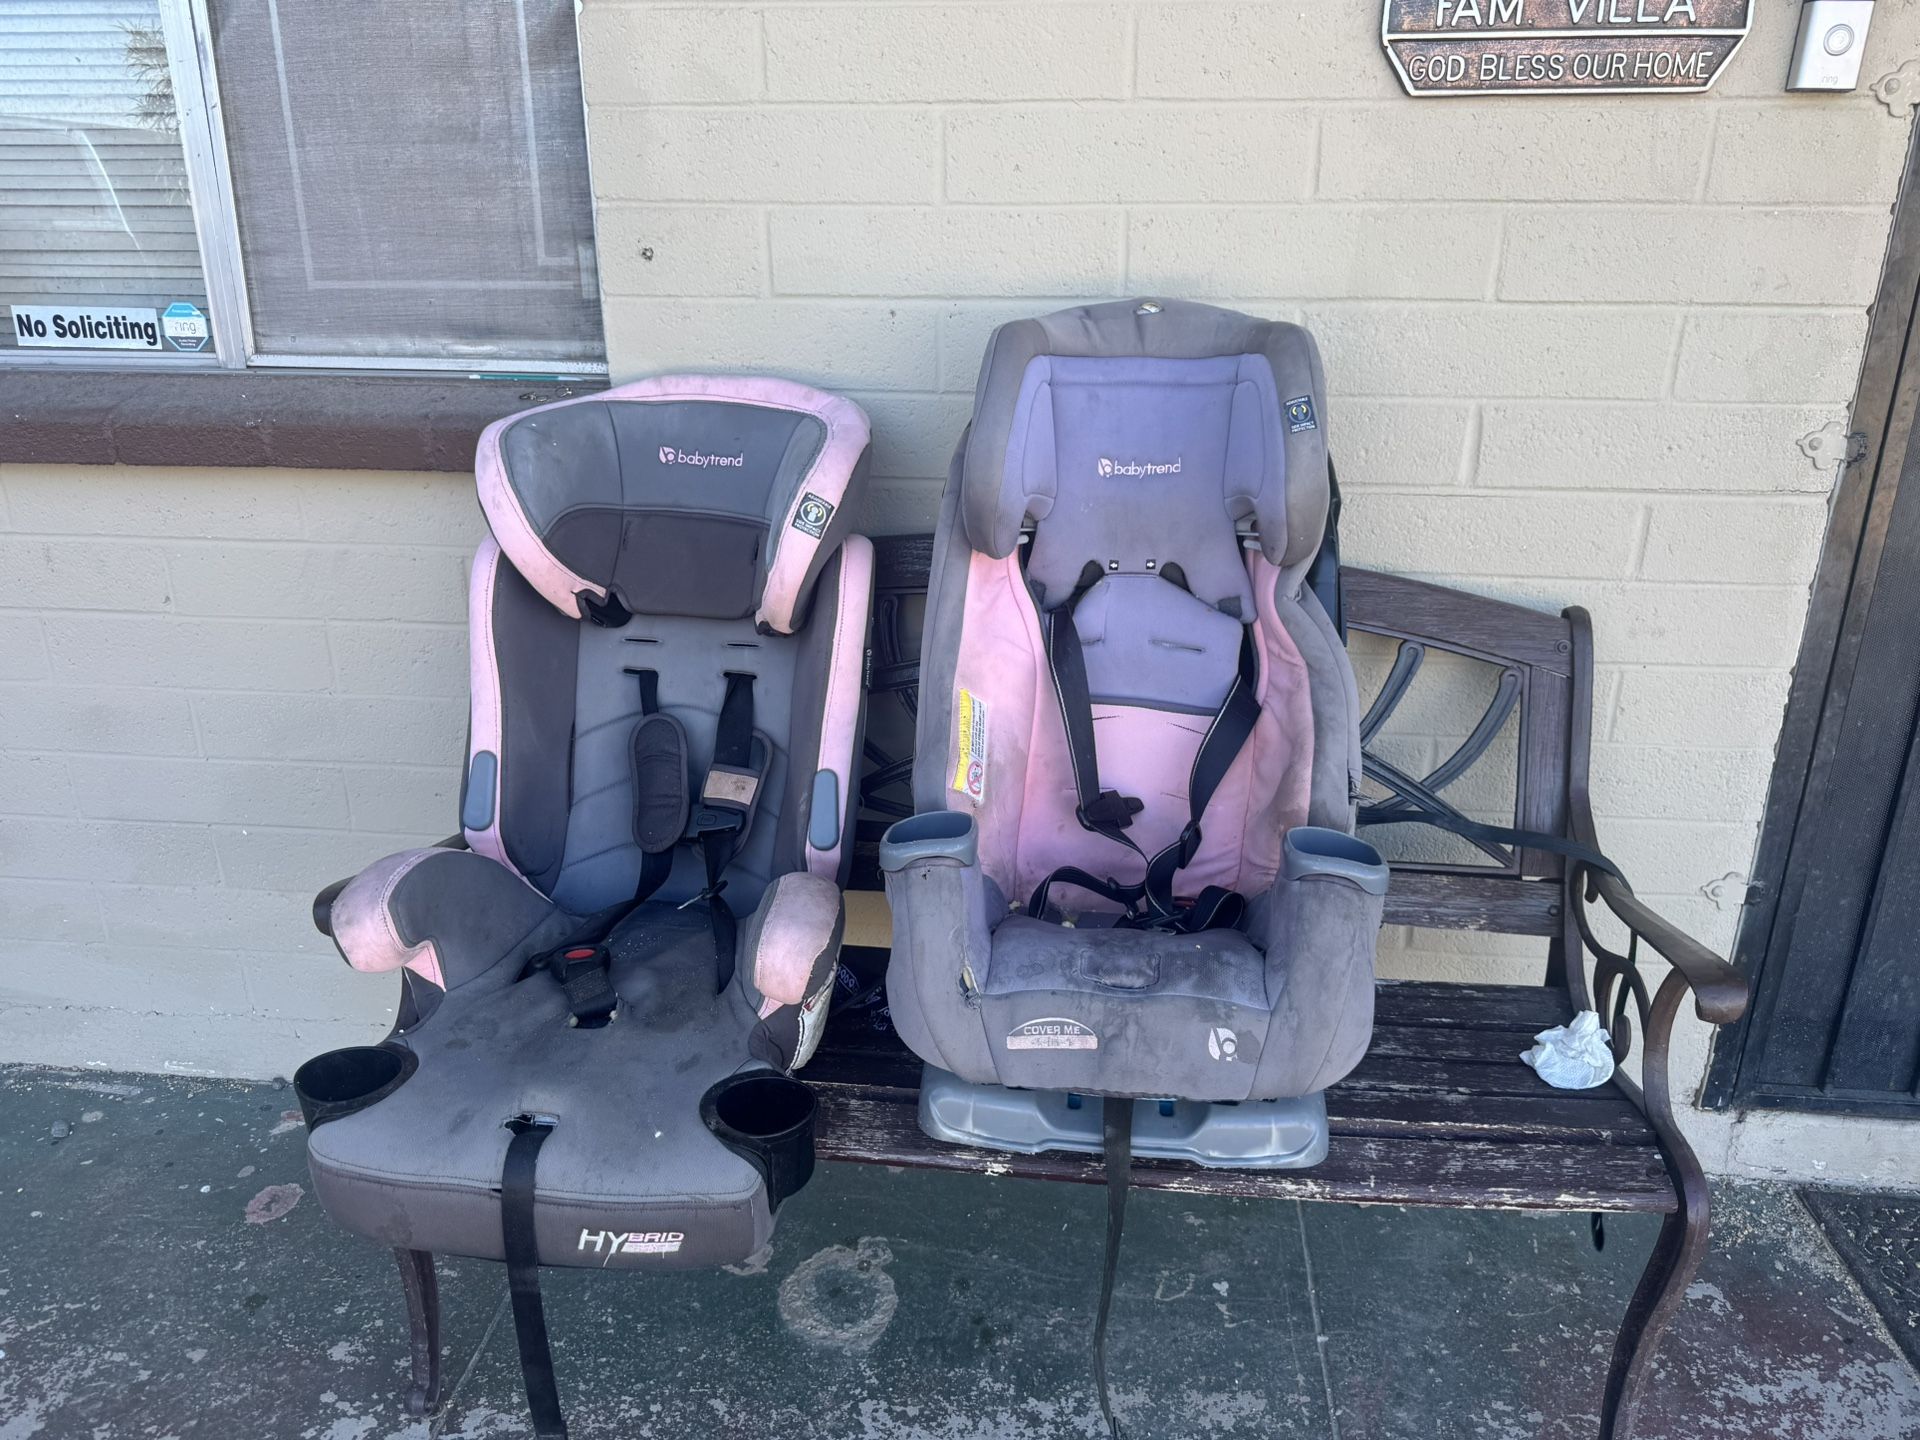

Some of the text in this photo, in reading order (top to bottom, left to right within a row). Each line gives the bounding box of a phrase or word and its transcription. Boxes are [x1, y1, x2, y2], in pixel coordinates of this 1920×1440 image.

[1568, 0, 1697, 25] VILLA
[1408, 51, 1714, 82] GOD BLESS OUR HOME
[16, 314, 158, 346] No Soliciting
[678, 449, 743, 469] babytrend
[1114, 457, 1181, 479] babytrend
[1023, 1024, 1081, 1035] COVER ME
[577, 1228, 685, 1255] HYBRID
